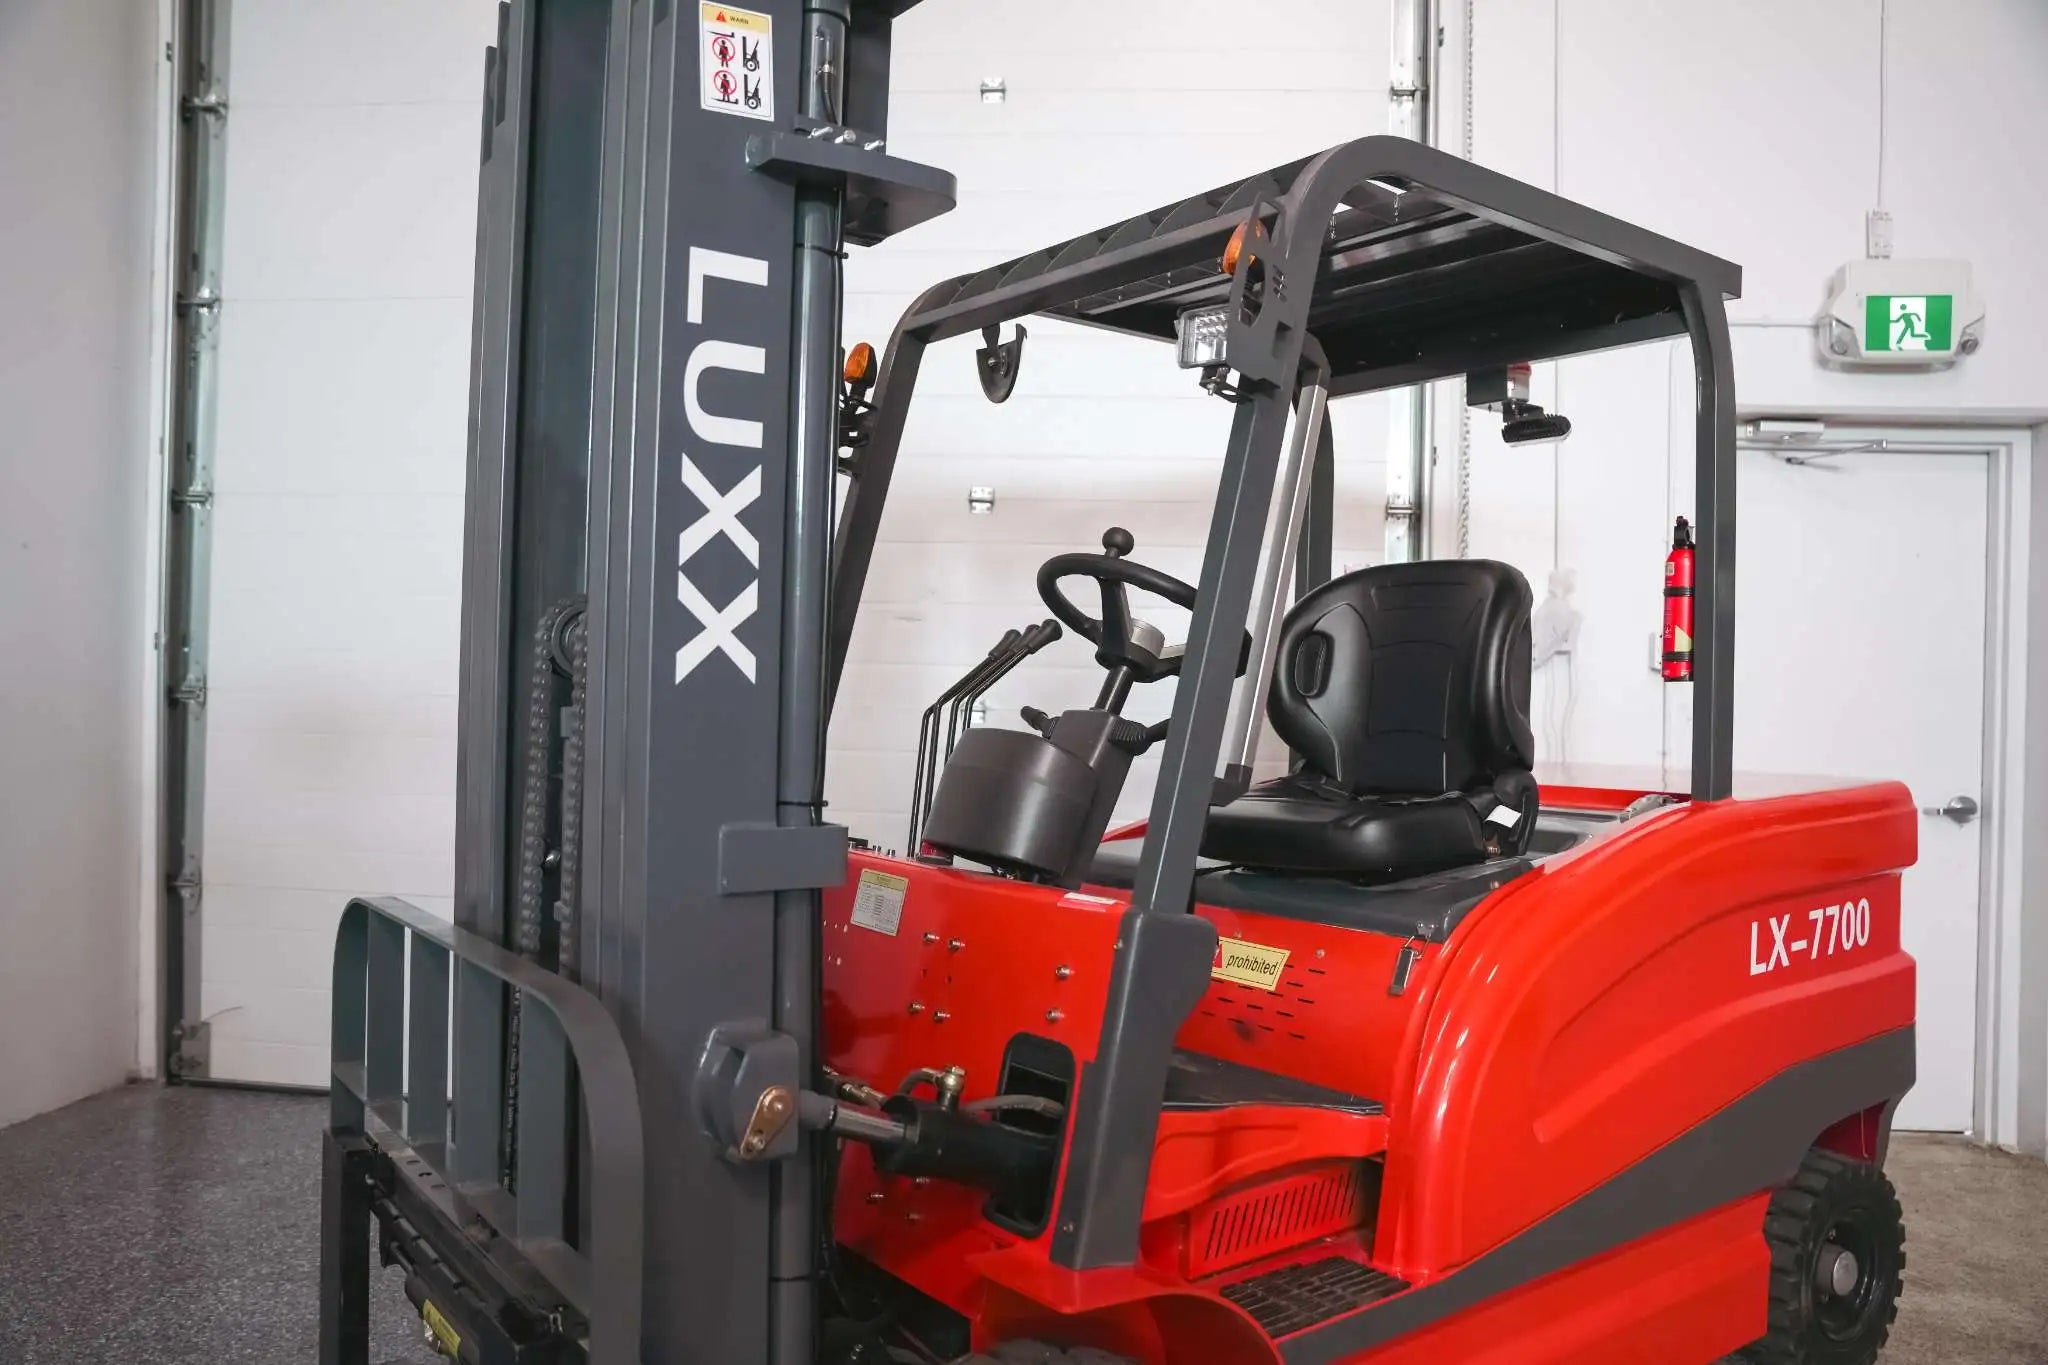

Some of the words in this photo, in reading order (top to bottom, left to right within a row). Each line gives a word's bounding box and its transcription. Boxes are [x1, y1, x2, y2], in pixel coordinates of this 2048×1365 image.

[675, 246, 769, 685] LUXX
[1226, 955, 1278, 976] prohibited
[1750, 898, 1870, 976] LX-7700
